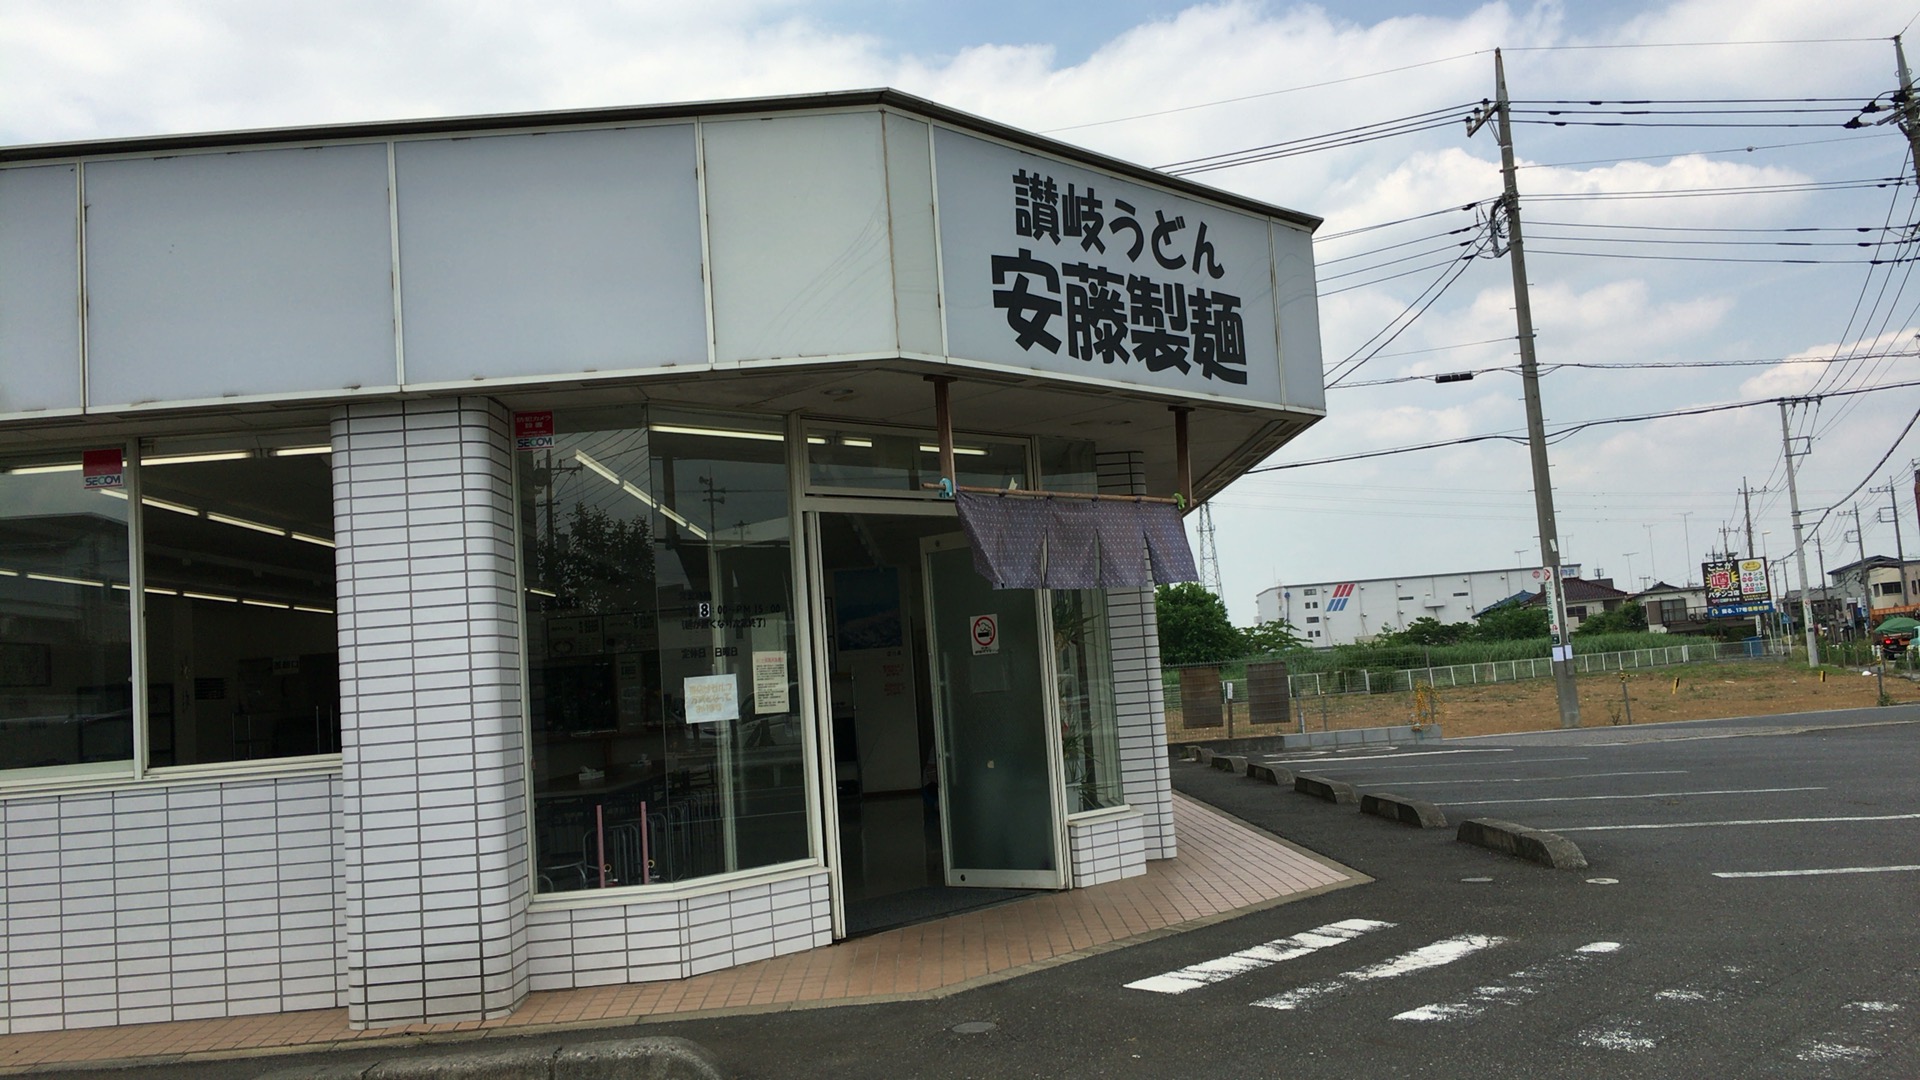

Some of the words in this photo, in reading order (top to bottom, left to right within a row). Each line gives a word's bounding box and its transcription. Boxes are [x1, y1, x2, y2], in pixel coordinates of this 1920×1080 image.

[1012, 168, 1225, 279] 讃岐うどん
[991, 248, 1247, 385] 安藤製麺
[517, 437, 552, 448] SECOM
[85, 475, 121, 486] SECOM
